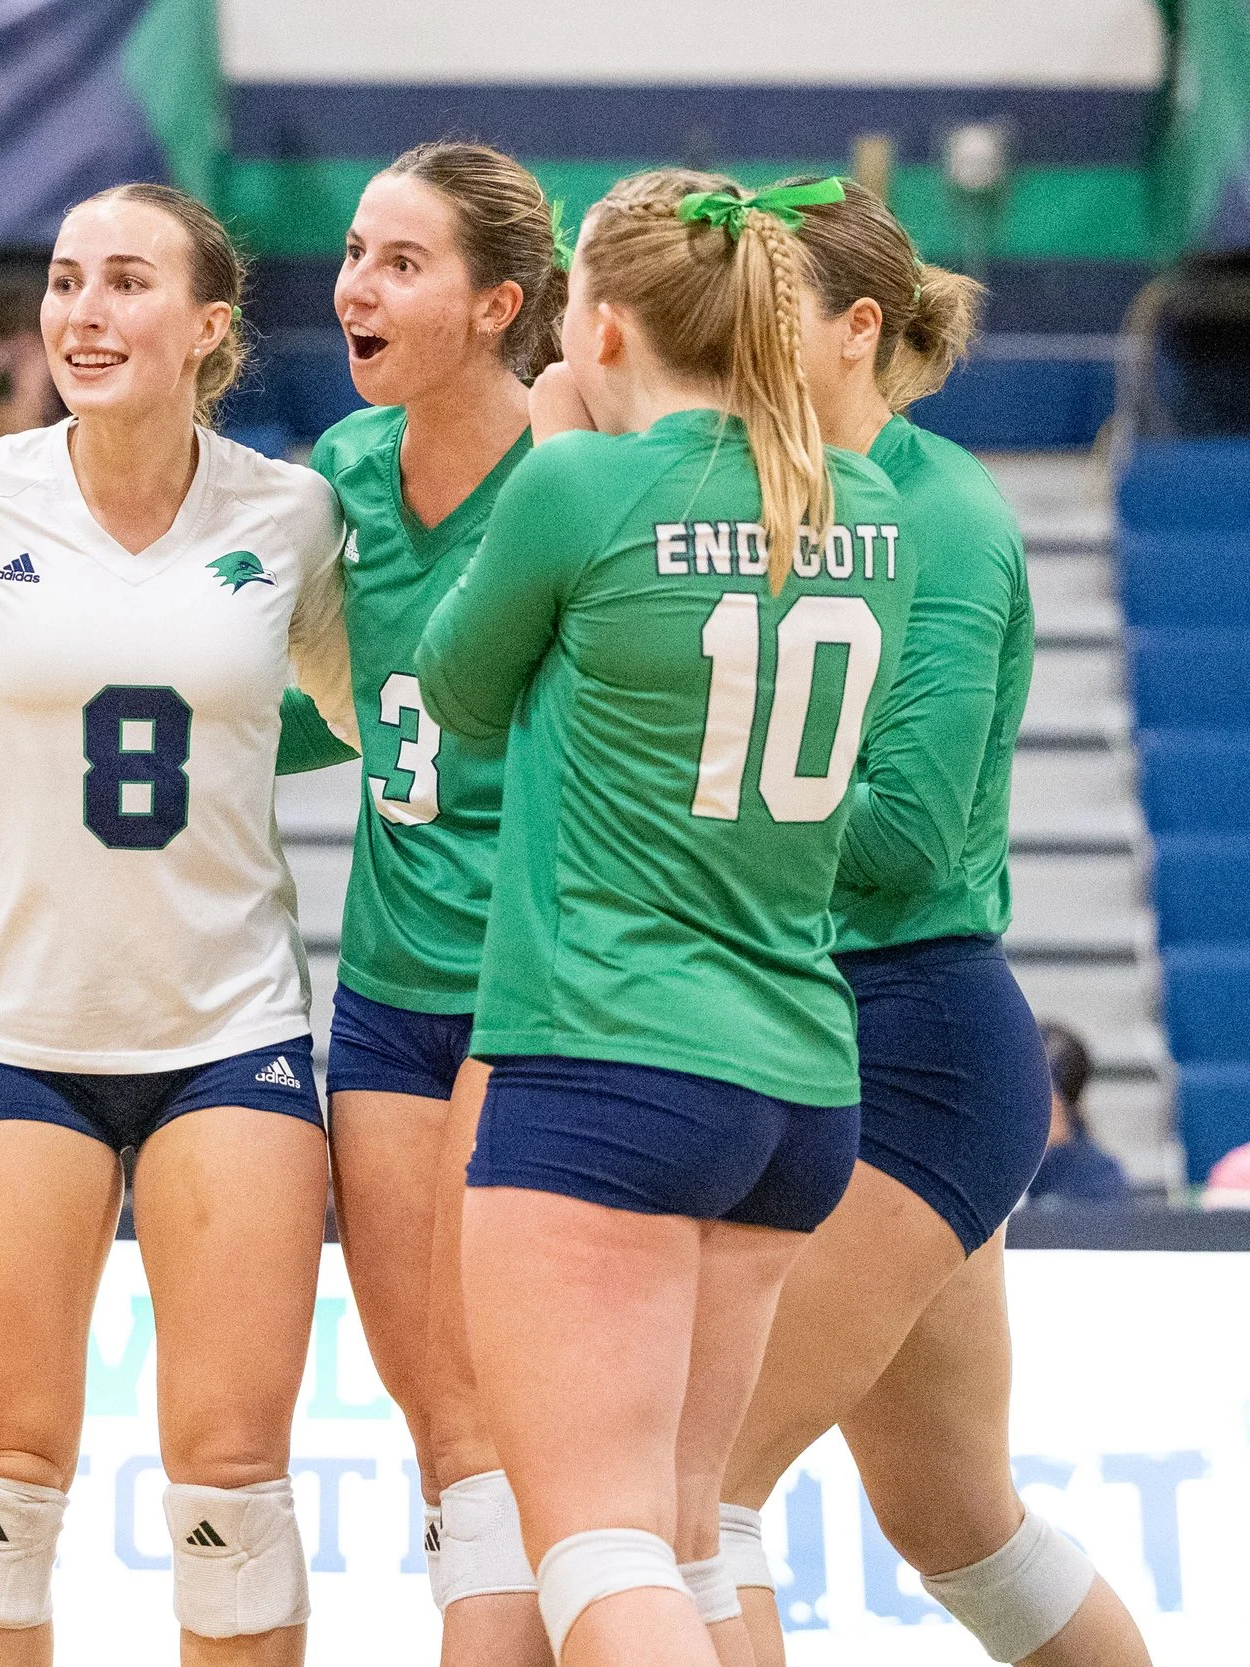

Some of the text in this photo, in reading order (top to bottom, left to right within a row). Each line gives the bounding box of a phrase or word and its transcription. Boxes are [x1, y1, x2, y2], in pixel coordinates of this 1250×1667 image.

[654, 521, 899, 580] ENDCOTT
[82, 684, 193, 850] 8
[367, 671, 442, 826] 3
[691, 592, 883, 823] 10
[254, 1071, 301, 1089] adidas
